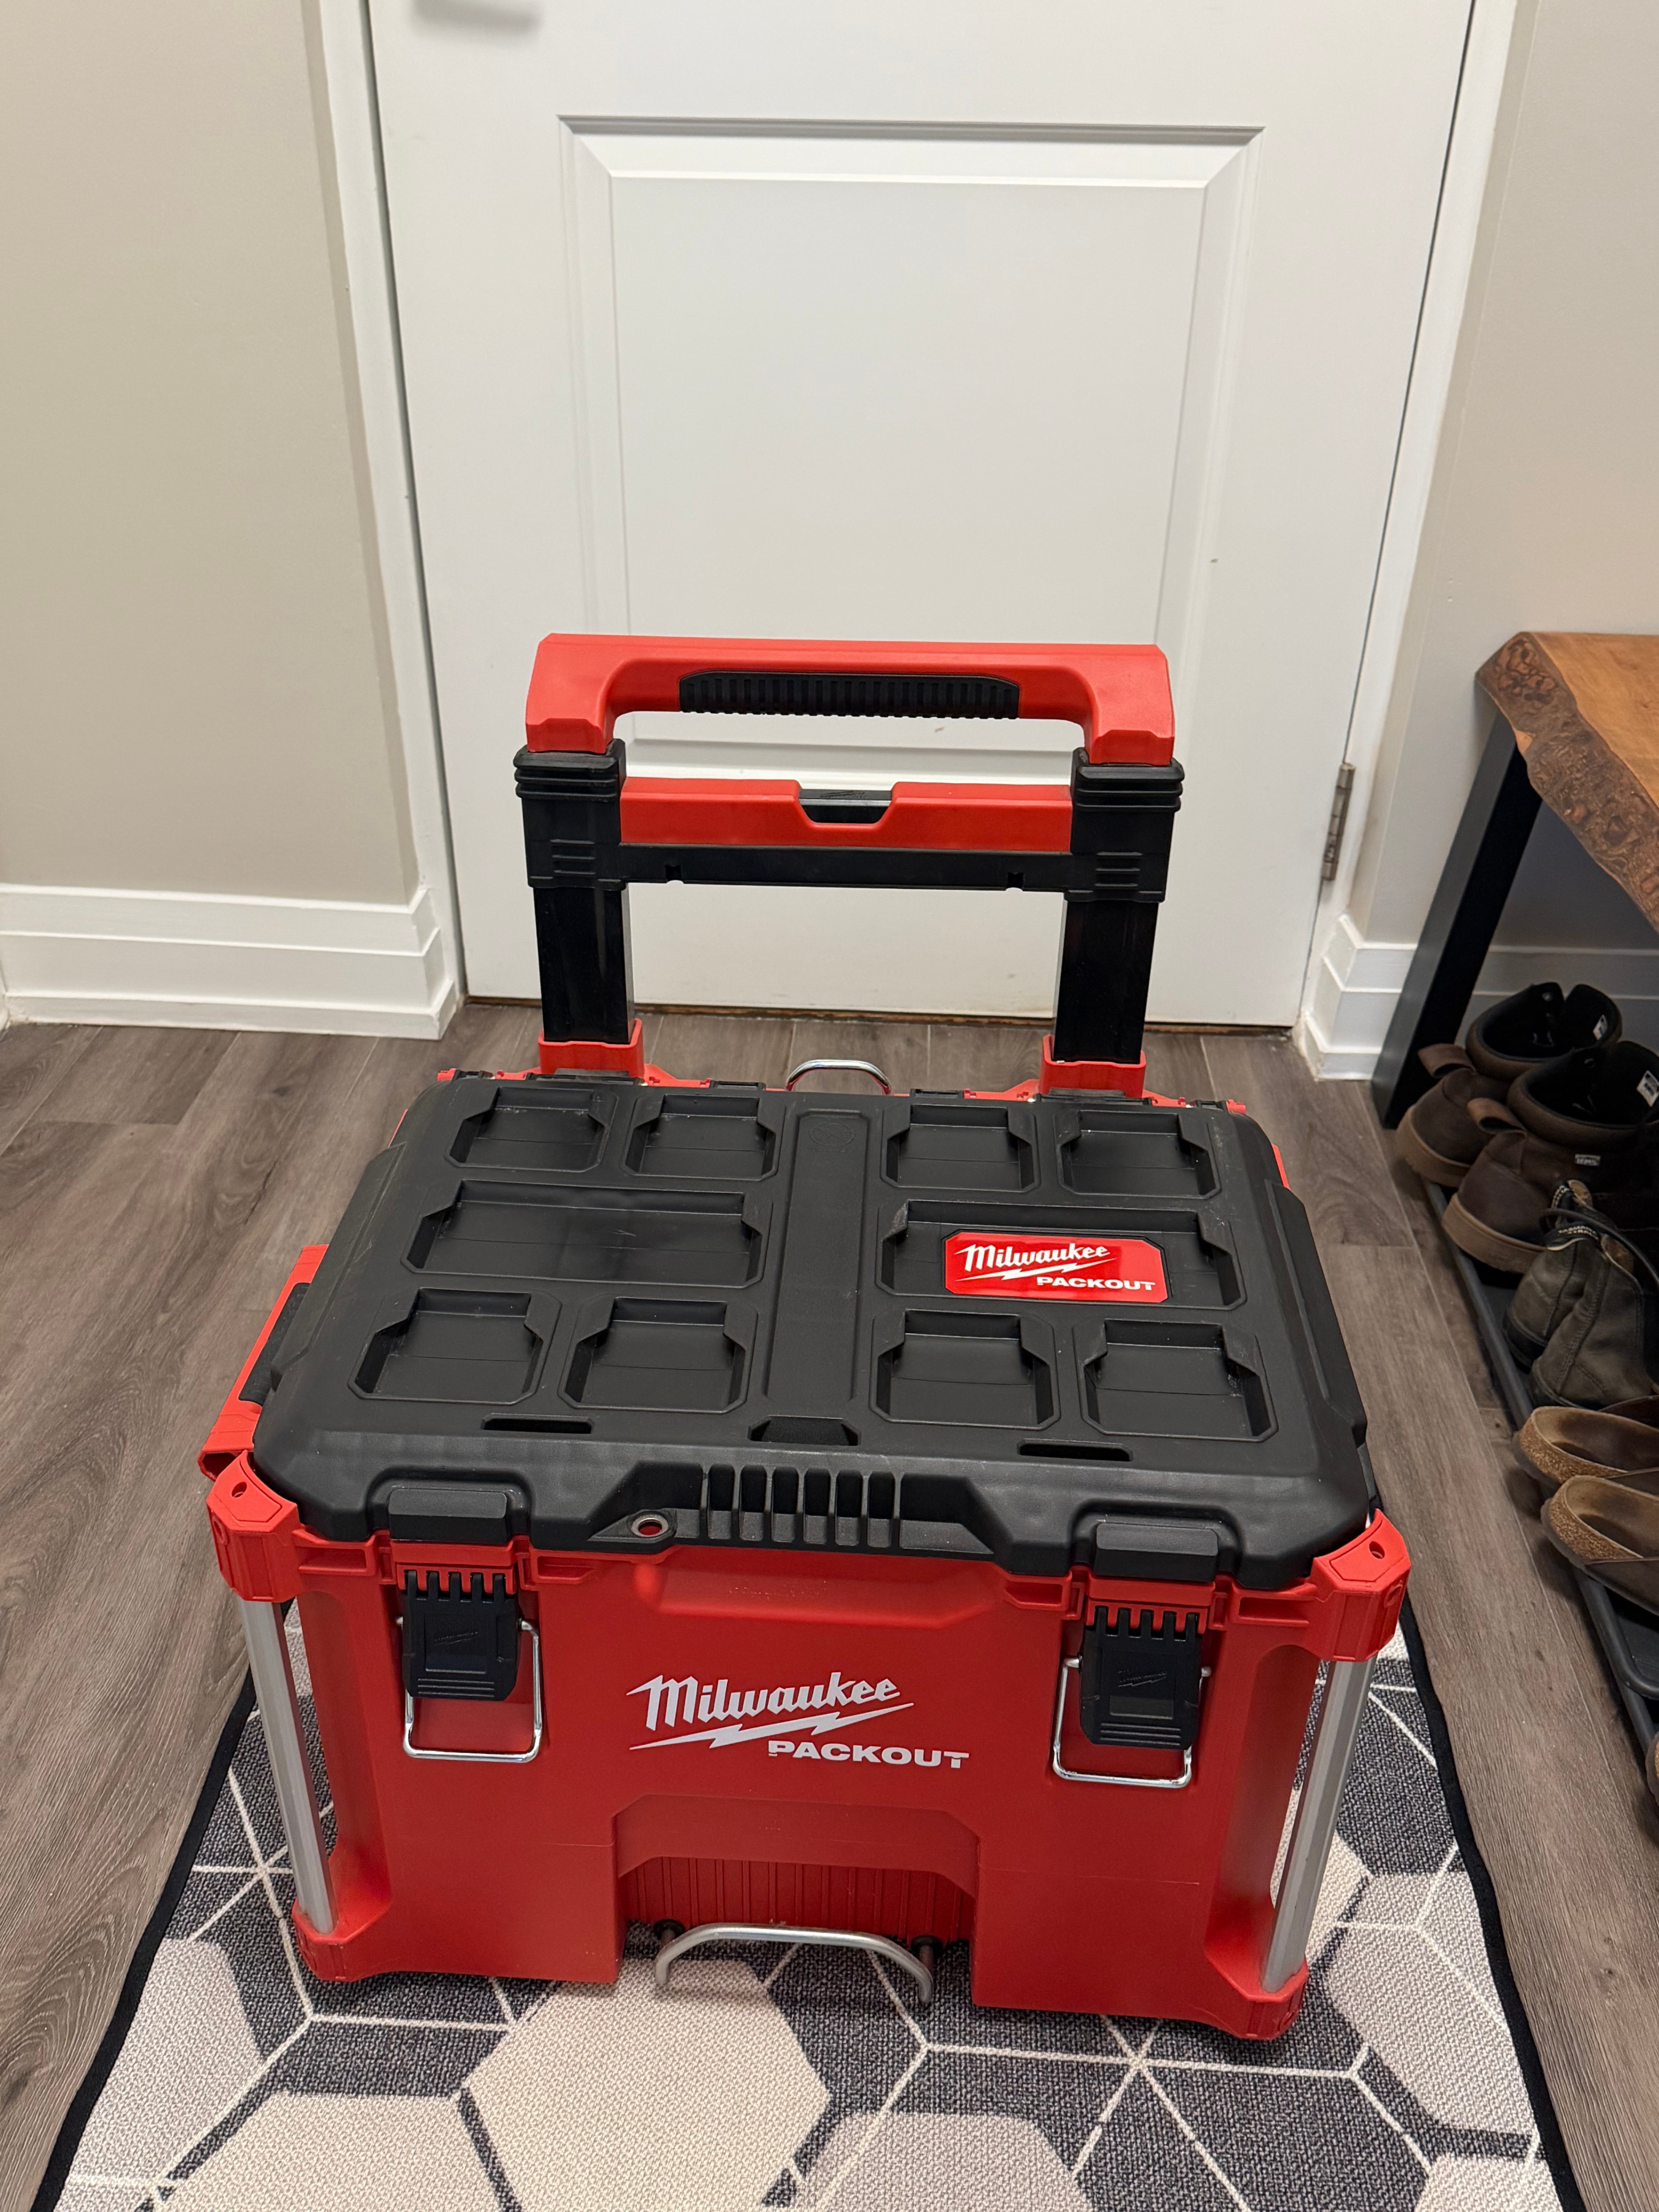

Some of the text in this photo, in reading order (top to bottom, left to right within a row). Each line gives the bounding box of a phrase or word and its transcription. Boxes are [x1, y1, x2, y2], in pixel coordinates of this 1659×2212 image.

[954, 1243, 1111, 1272] Milwaukee
[1037, 1276, 1156, 1291] PACKOUT
[626, 1672, 901, 1731] Milwaukee
[768, 1740, 970, 1769] PACKOUT
